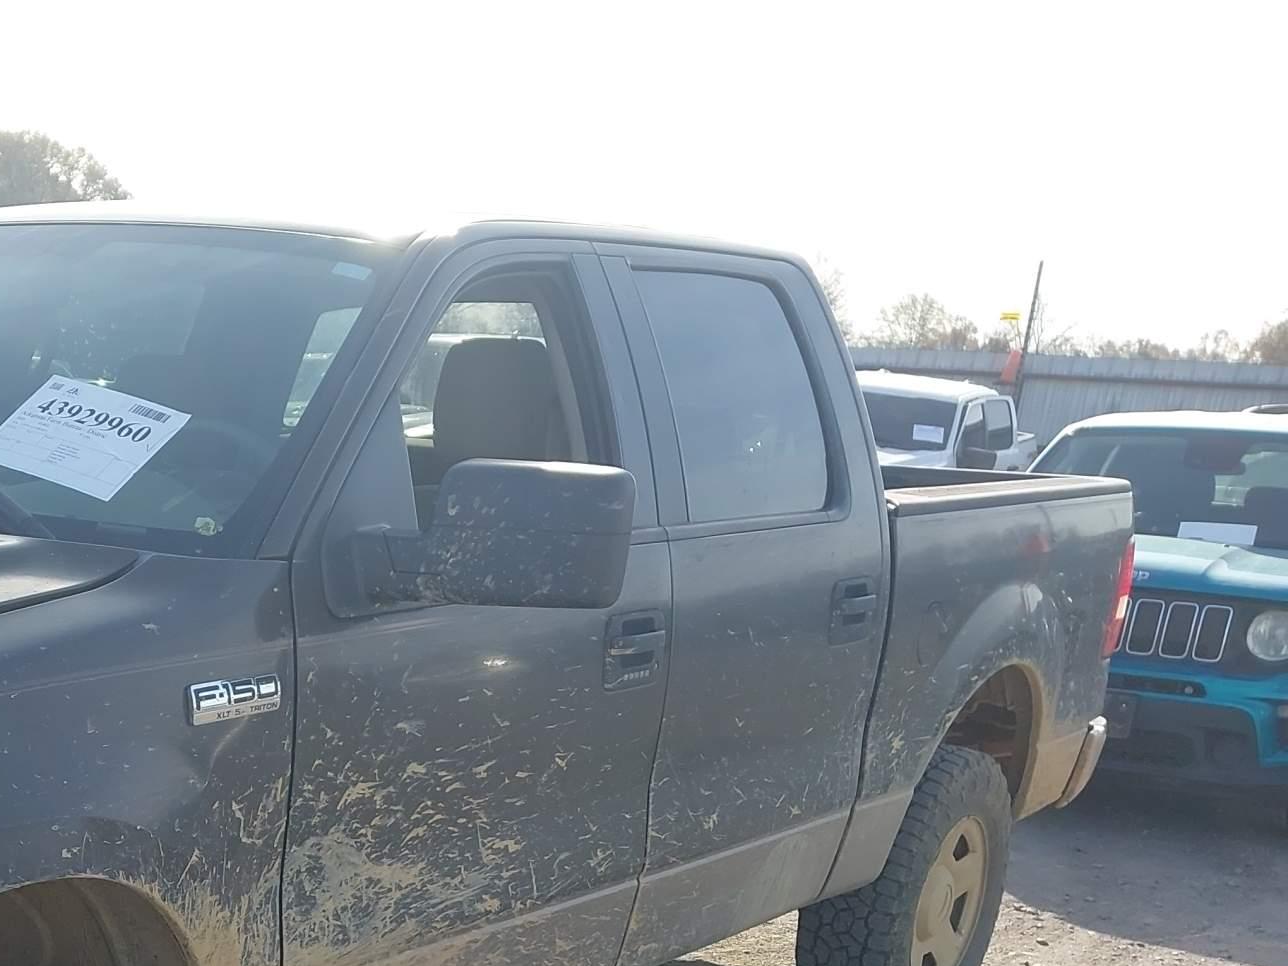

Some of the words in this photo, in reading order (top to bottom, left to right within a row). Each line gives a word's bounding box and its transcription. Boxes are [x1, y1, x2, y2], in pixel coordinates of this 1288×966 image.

[37, 398, 152, 443] 43929960
[215, 710, 231, 720] XLT
[250, 702, 278, 713] TRITON
